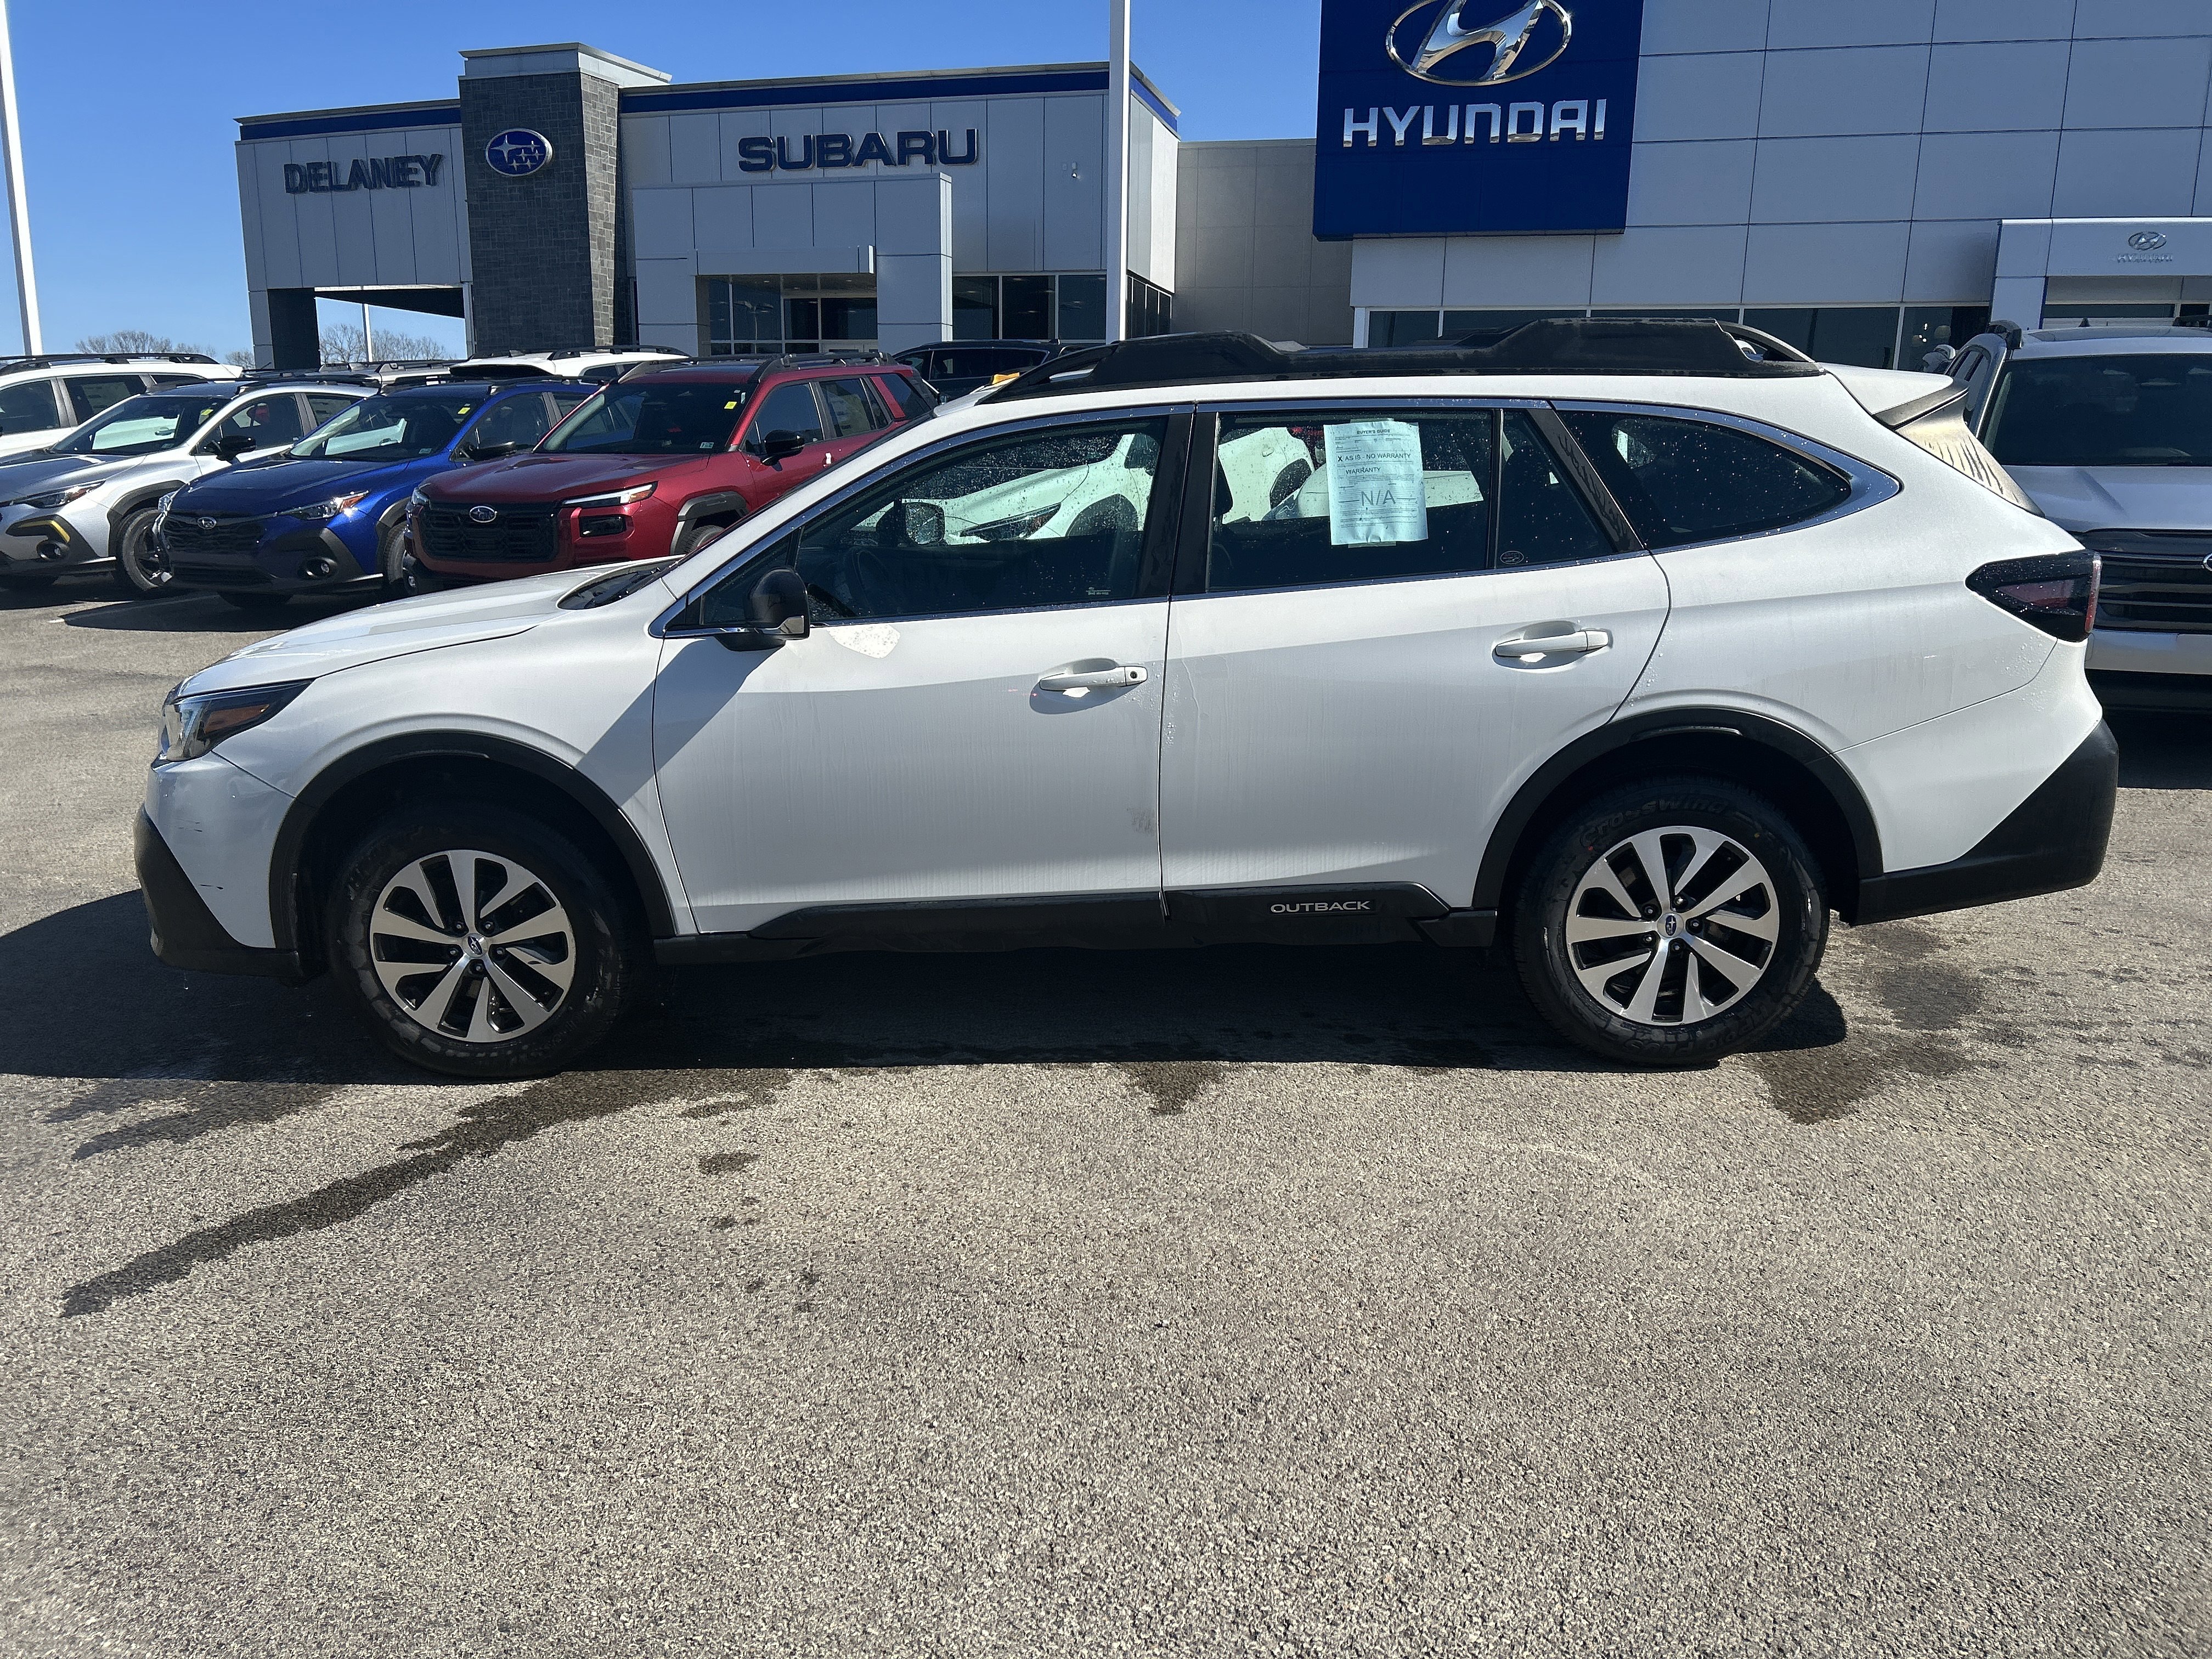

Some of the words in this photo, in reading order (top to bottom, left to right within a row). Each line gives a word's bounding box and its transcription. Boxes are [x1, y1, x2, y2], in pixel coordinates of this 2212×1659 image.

[1342, 99, 1607, 147] HYUNDAI
[738, 128, 979, 172] SUBARU
[284, 154, 444, 194] DELANEY
[1361, 490, 1396, 506] N/A
[1271, 900, 1370, 913] OUTBACK
